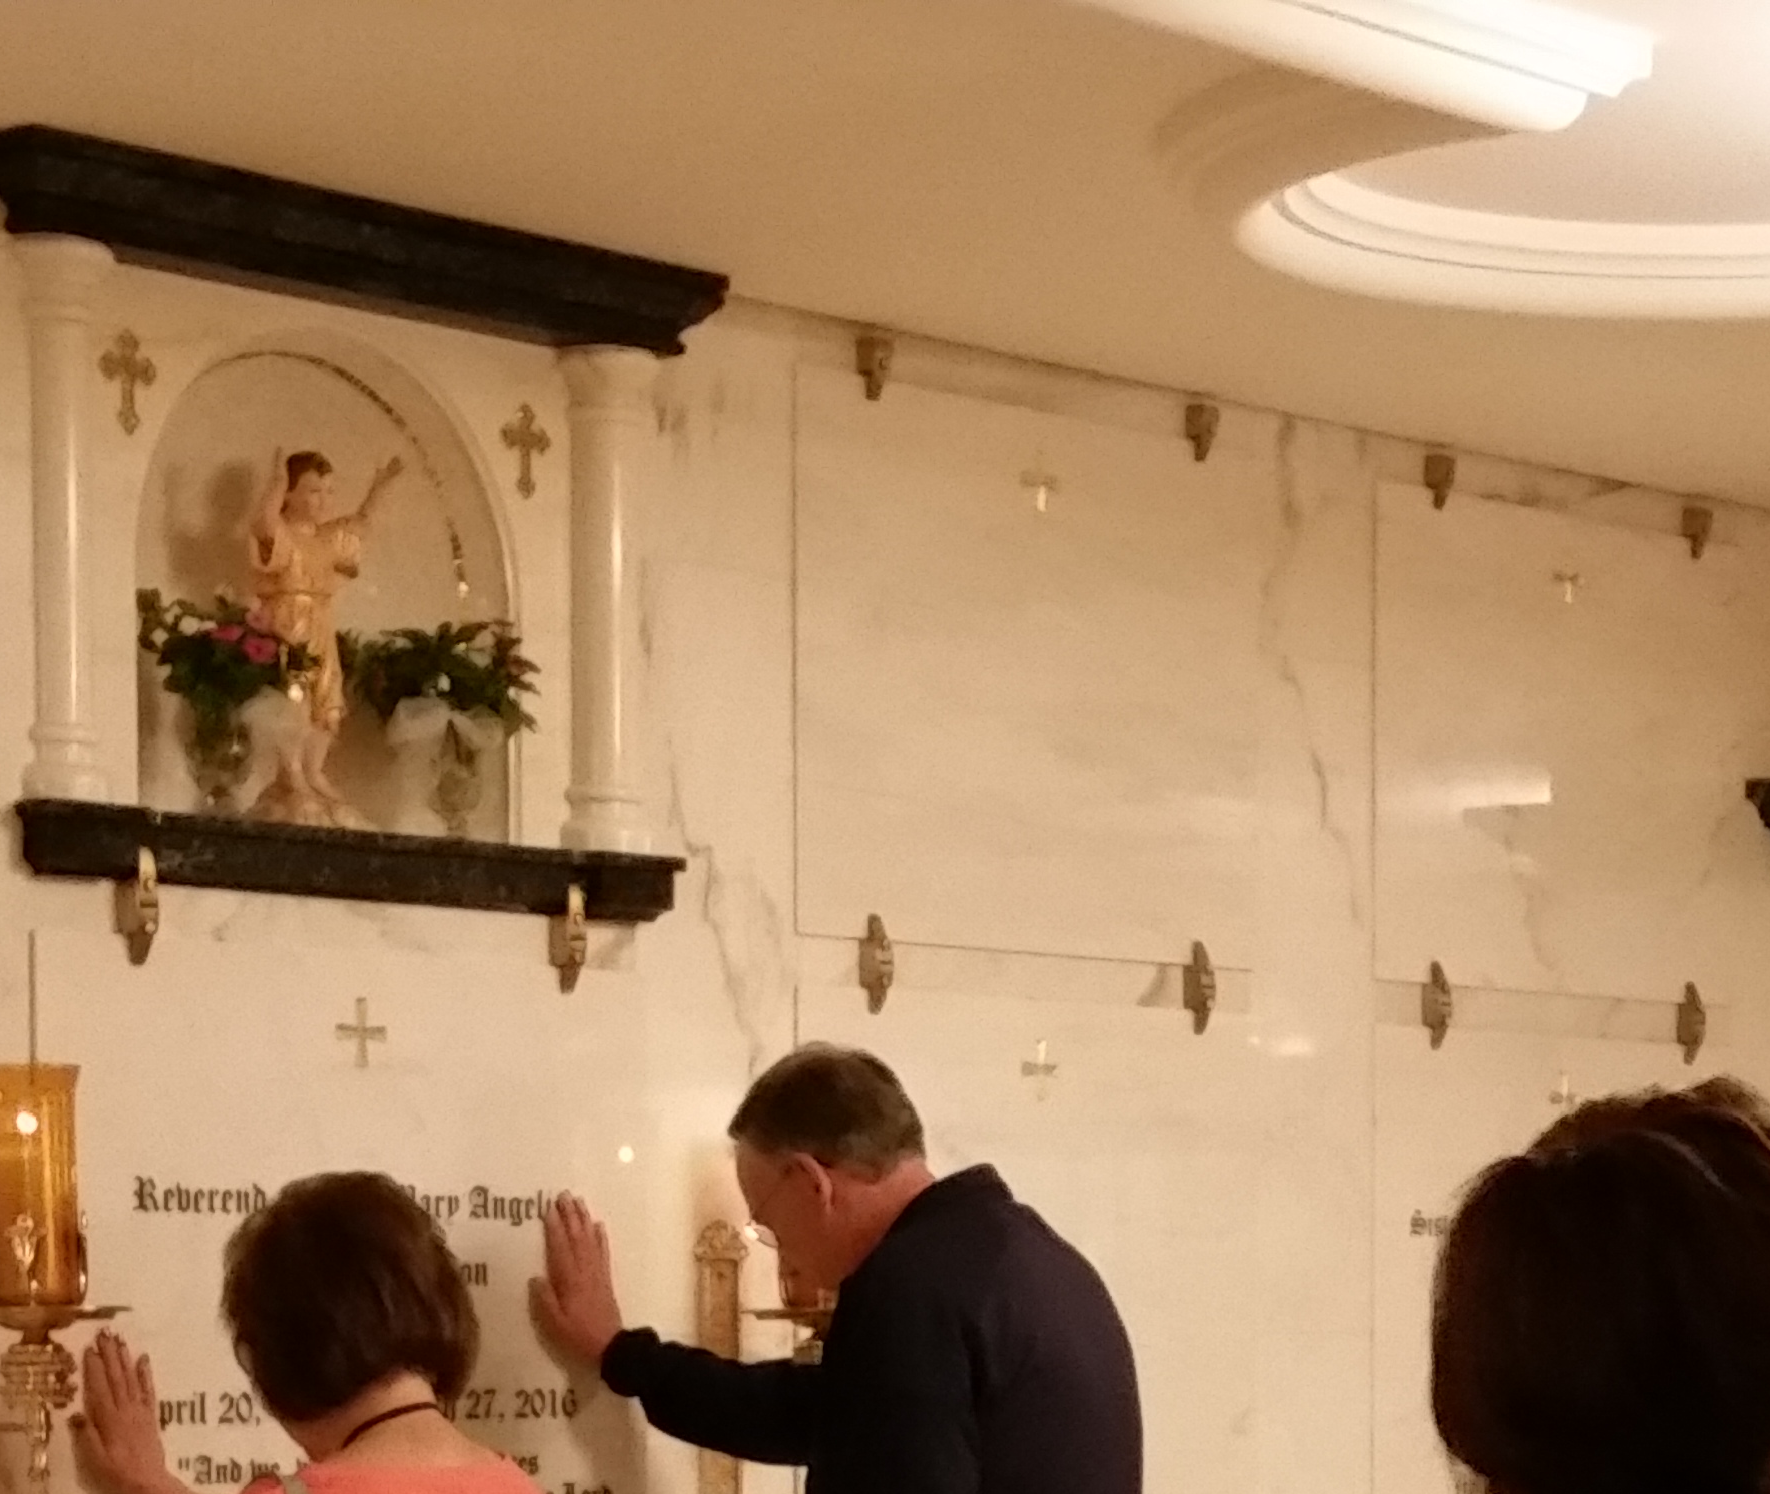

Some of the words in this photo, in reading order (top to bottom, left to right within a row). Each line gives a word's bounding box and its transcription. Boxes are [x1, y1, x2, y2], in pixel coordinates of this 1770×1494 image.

[132, 1175, 267, 1214] Reverend
[159, 1391, 207, 1431] pril
[218, 1391, 262, 1427] 20,
[514, 1388, 579, 1421] 2016
